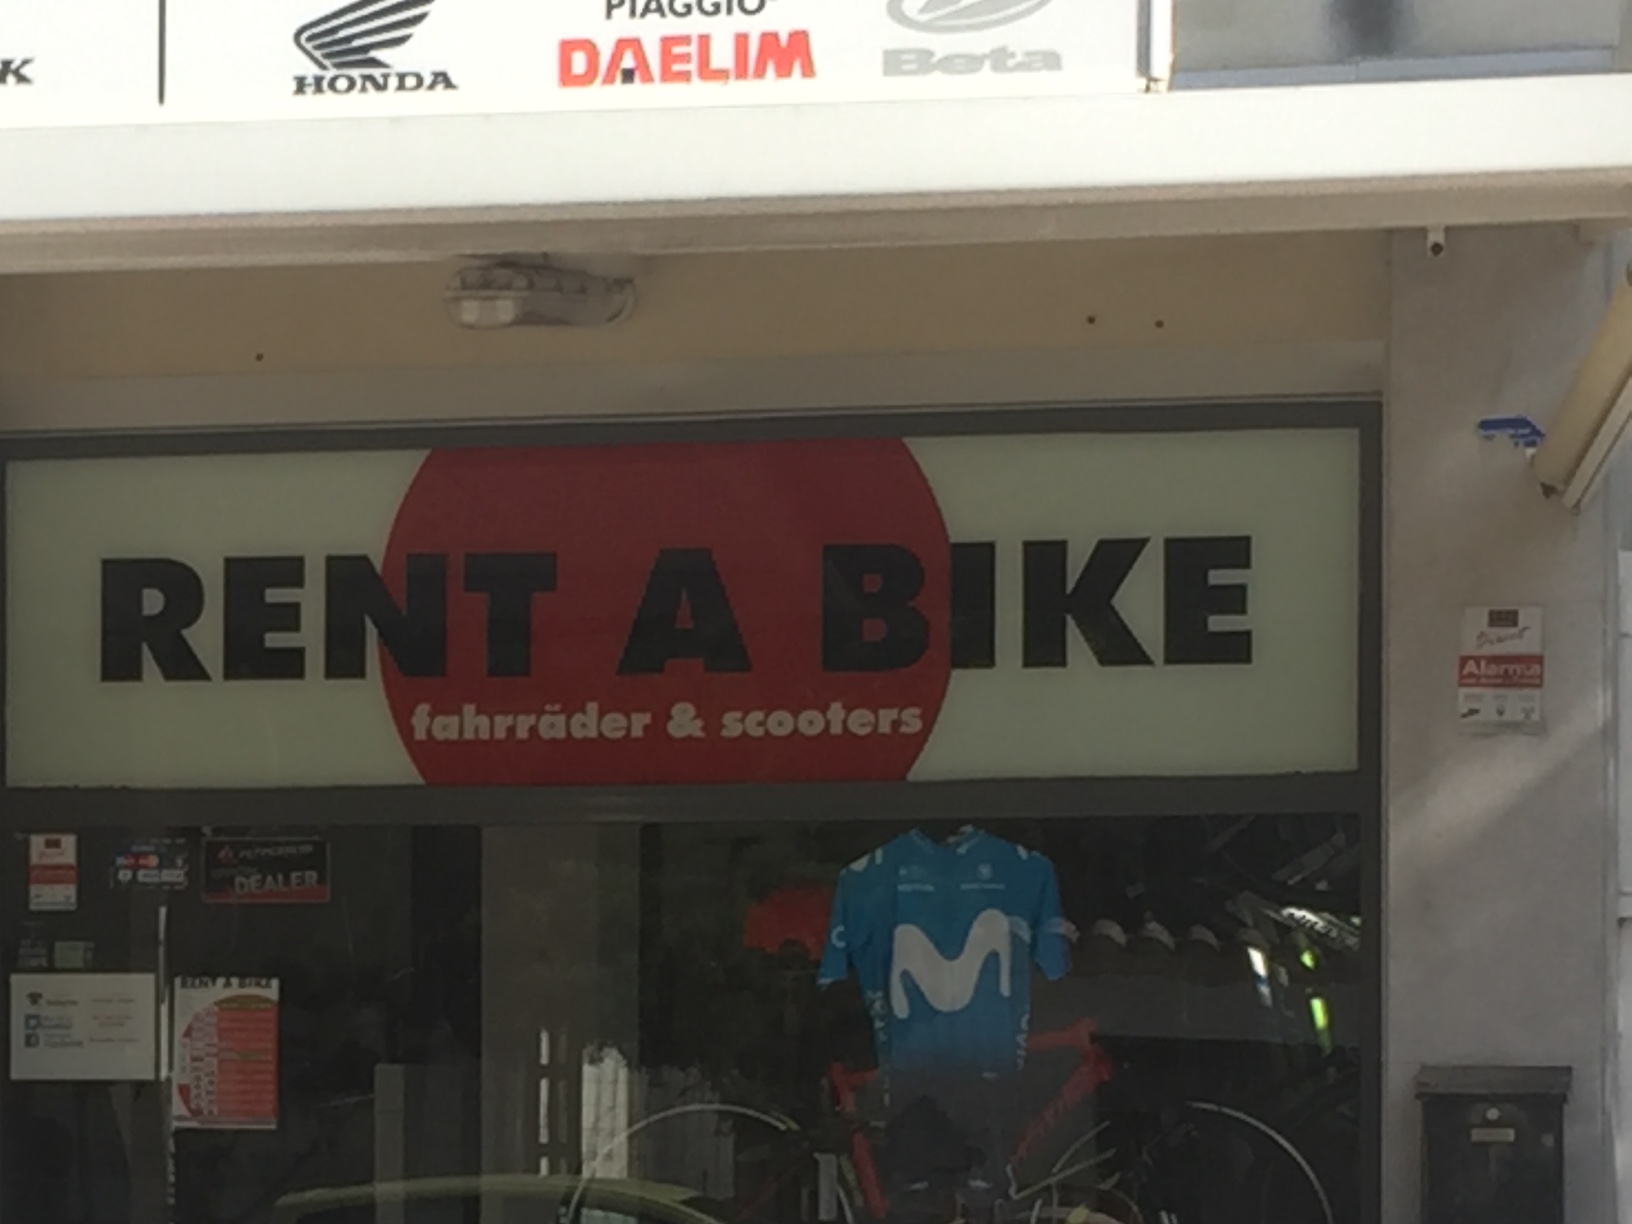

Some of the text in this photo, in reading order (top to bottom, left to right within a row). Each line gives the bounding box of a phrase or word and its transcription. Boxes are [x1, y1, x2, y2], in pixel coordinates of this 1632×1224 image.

[558, 30, 815, 88] DAELIM
[881, 45, 1063, 78] Beta
[292, 68, 458, 96] HONDA
[100, 535, 1255, 683] RENT A BIKE
[1462, 659, 1542, 677] Alarma
[410, 699, 924, 744] fahrräder & scooters
[234, 870, 319, 895] DEALER
